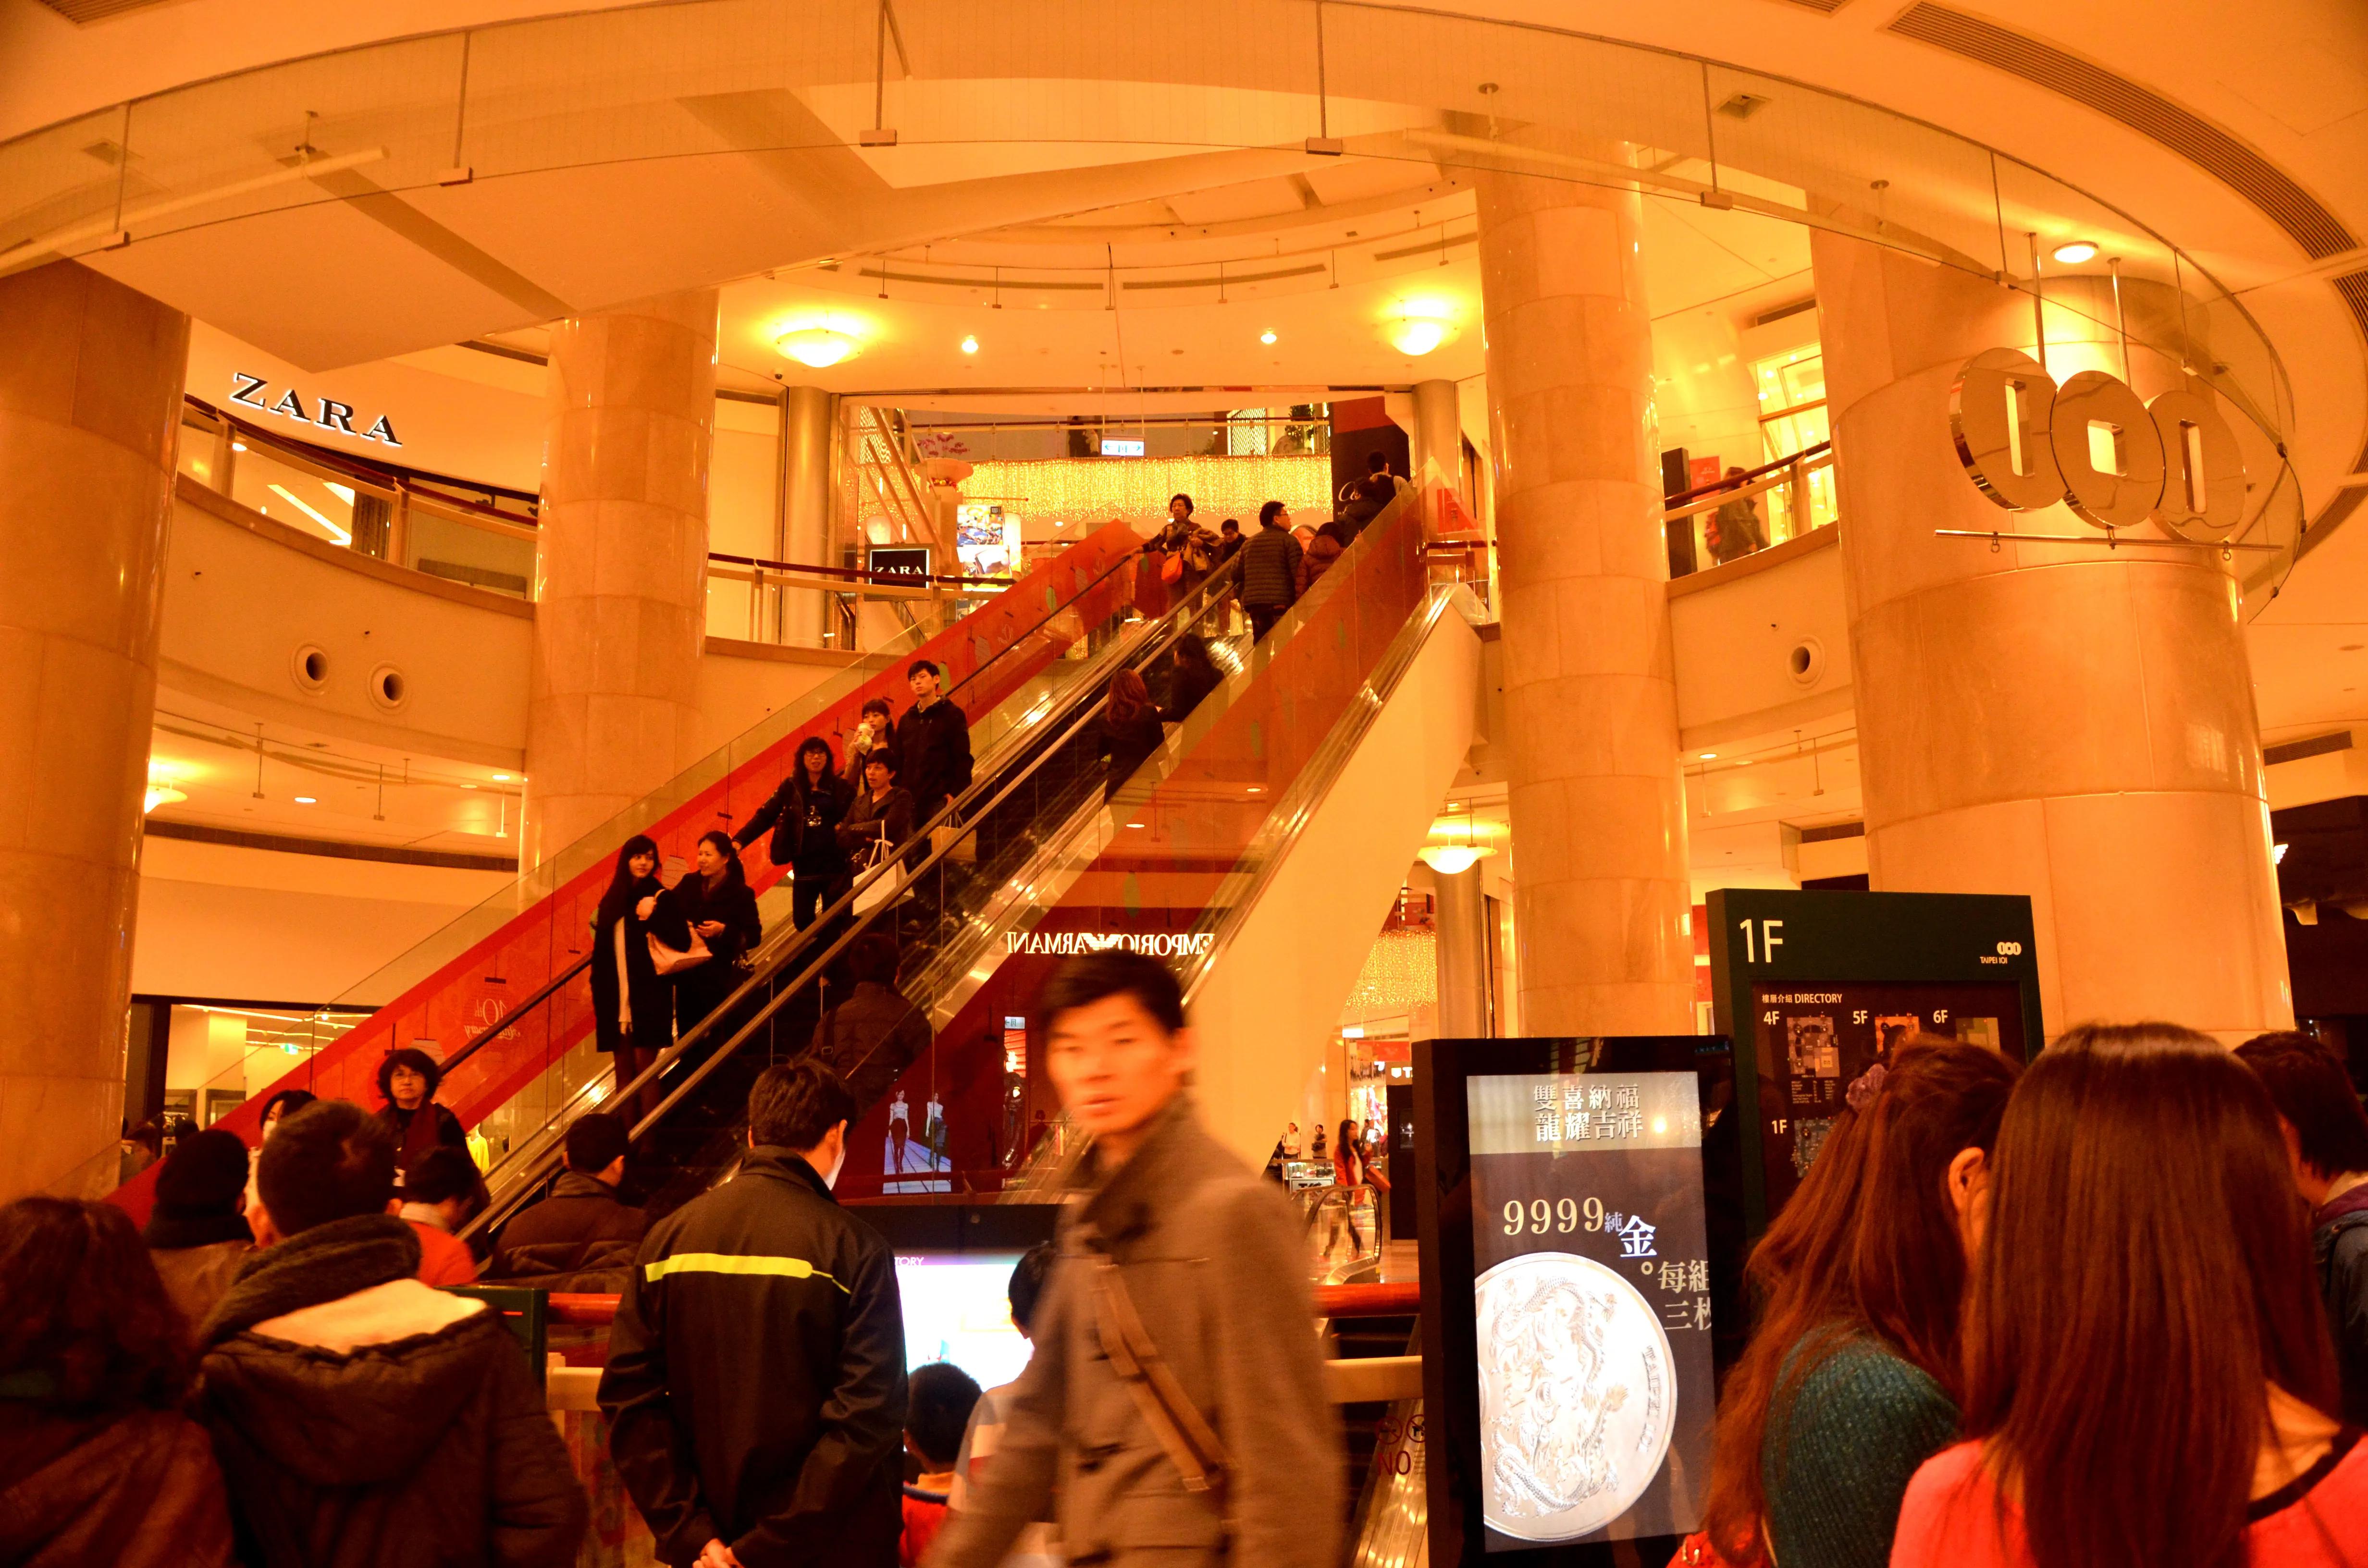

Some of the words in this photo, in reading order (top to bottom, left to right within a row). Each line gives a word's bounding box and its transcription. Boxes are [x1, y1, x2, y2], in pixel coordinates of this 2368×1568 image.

[230, 372, 403, 447] ZARA
[875, 566, 924, 574] ZARA
[1739, 919, 1783, 963] 1F
[1795, 993, 1842, 1003] DIRECTORY
[1764, 1011, 1779, 1025] 4F
[1853, 1010, 1868, 1024] 5F
[1933, 1010, 1948, 1023] 6F
[1534, 1083, 1639, 1111] 雙喜納福
[1535, 1110, 1643, 1142] 龍耀吉祥
[1772, 1119, 1787, 1134] 1F
[894, 1256, 925, 1265] TORY
[1377, 1450, 1411, 1475] NO
